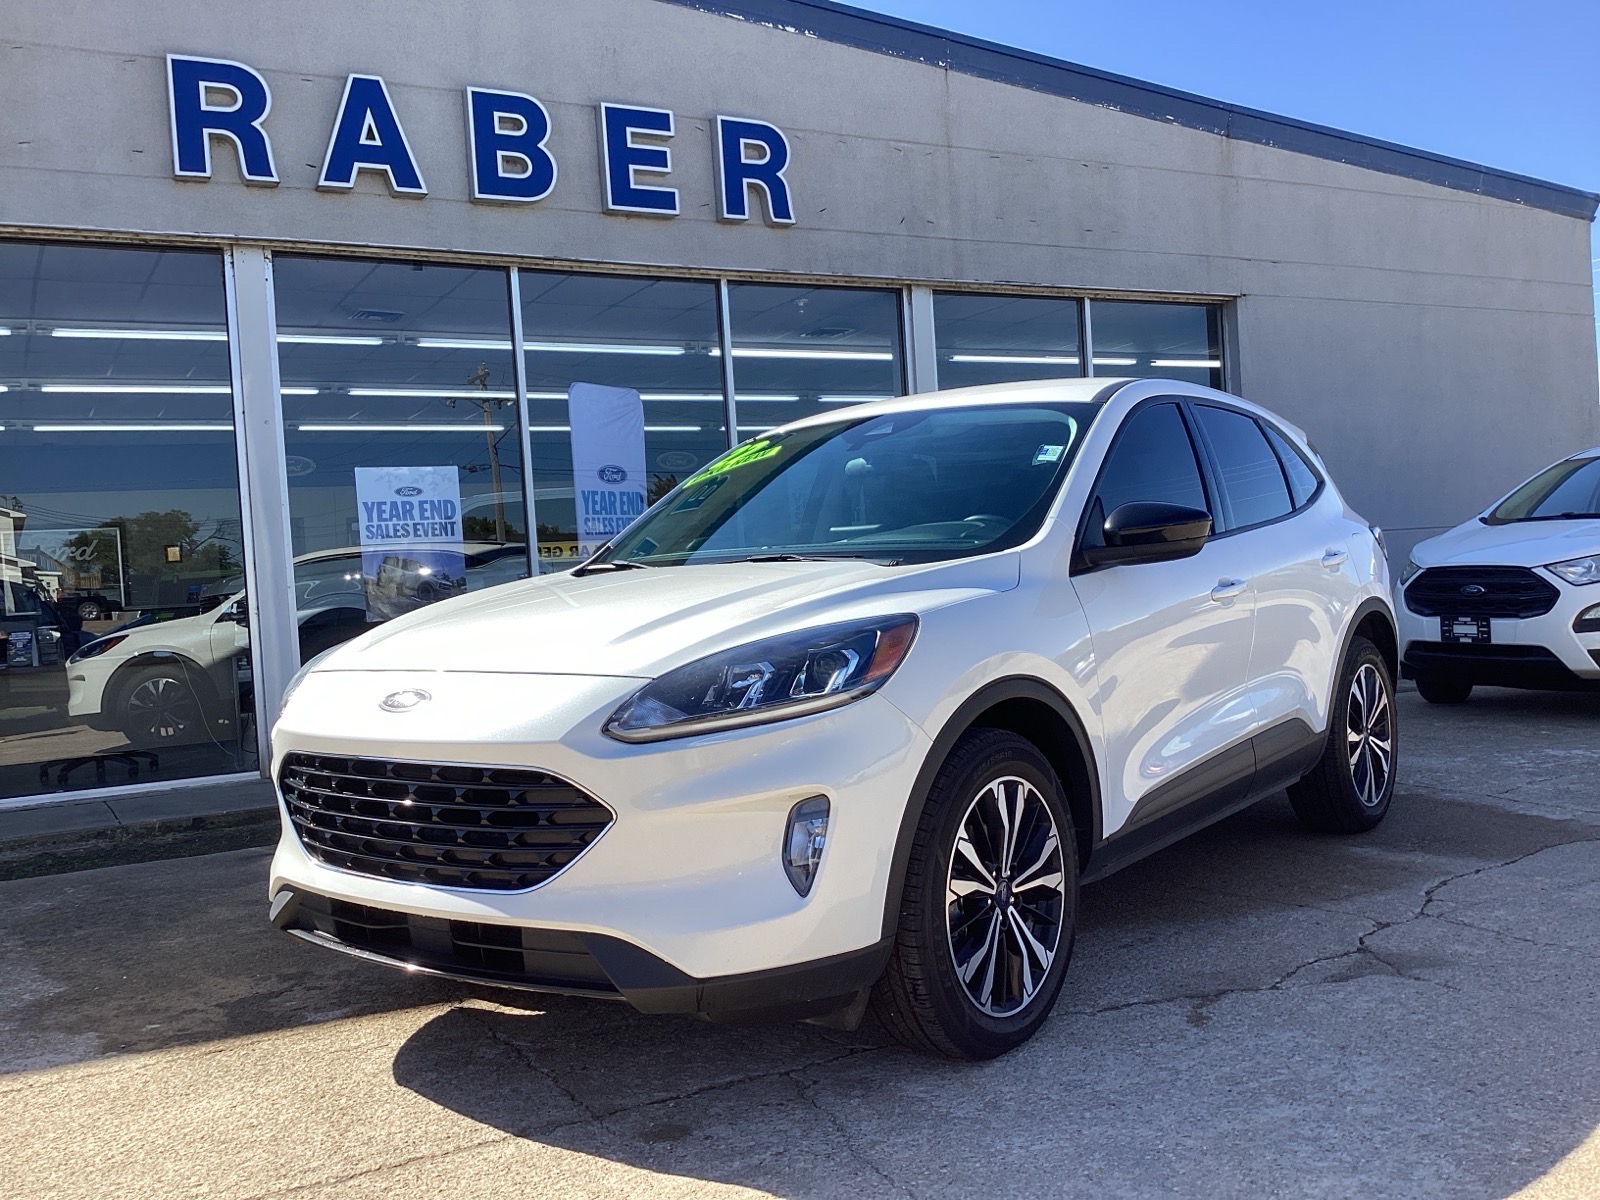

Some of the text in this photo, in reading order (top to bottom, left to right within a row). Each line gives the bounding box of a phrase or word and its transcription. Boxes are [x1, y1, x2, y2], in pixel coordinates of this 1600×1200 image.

[165, 53, 797, 227] RABER
[362, 500, 456, 522] YEAR END
[581, 490, 644, 516] YEAR END
[366, 521, 456, 539] SALES EVENT
[584, 517, 614, 535] SALES
